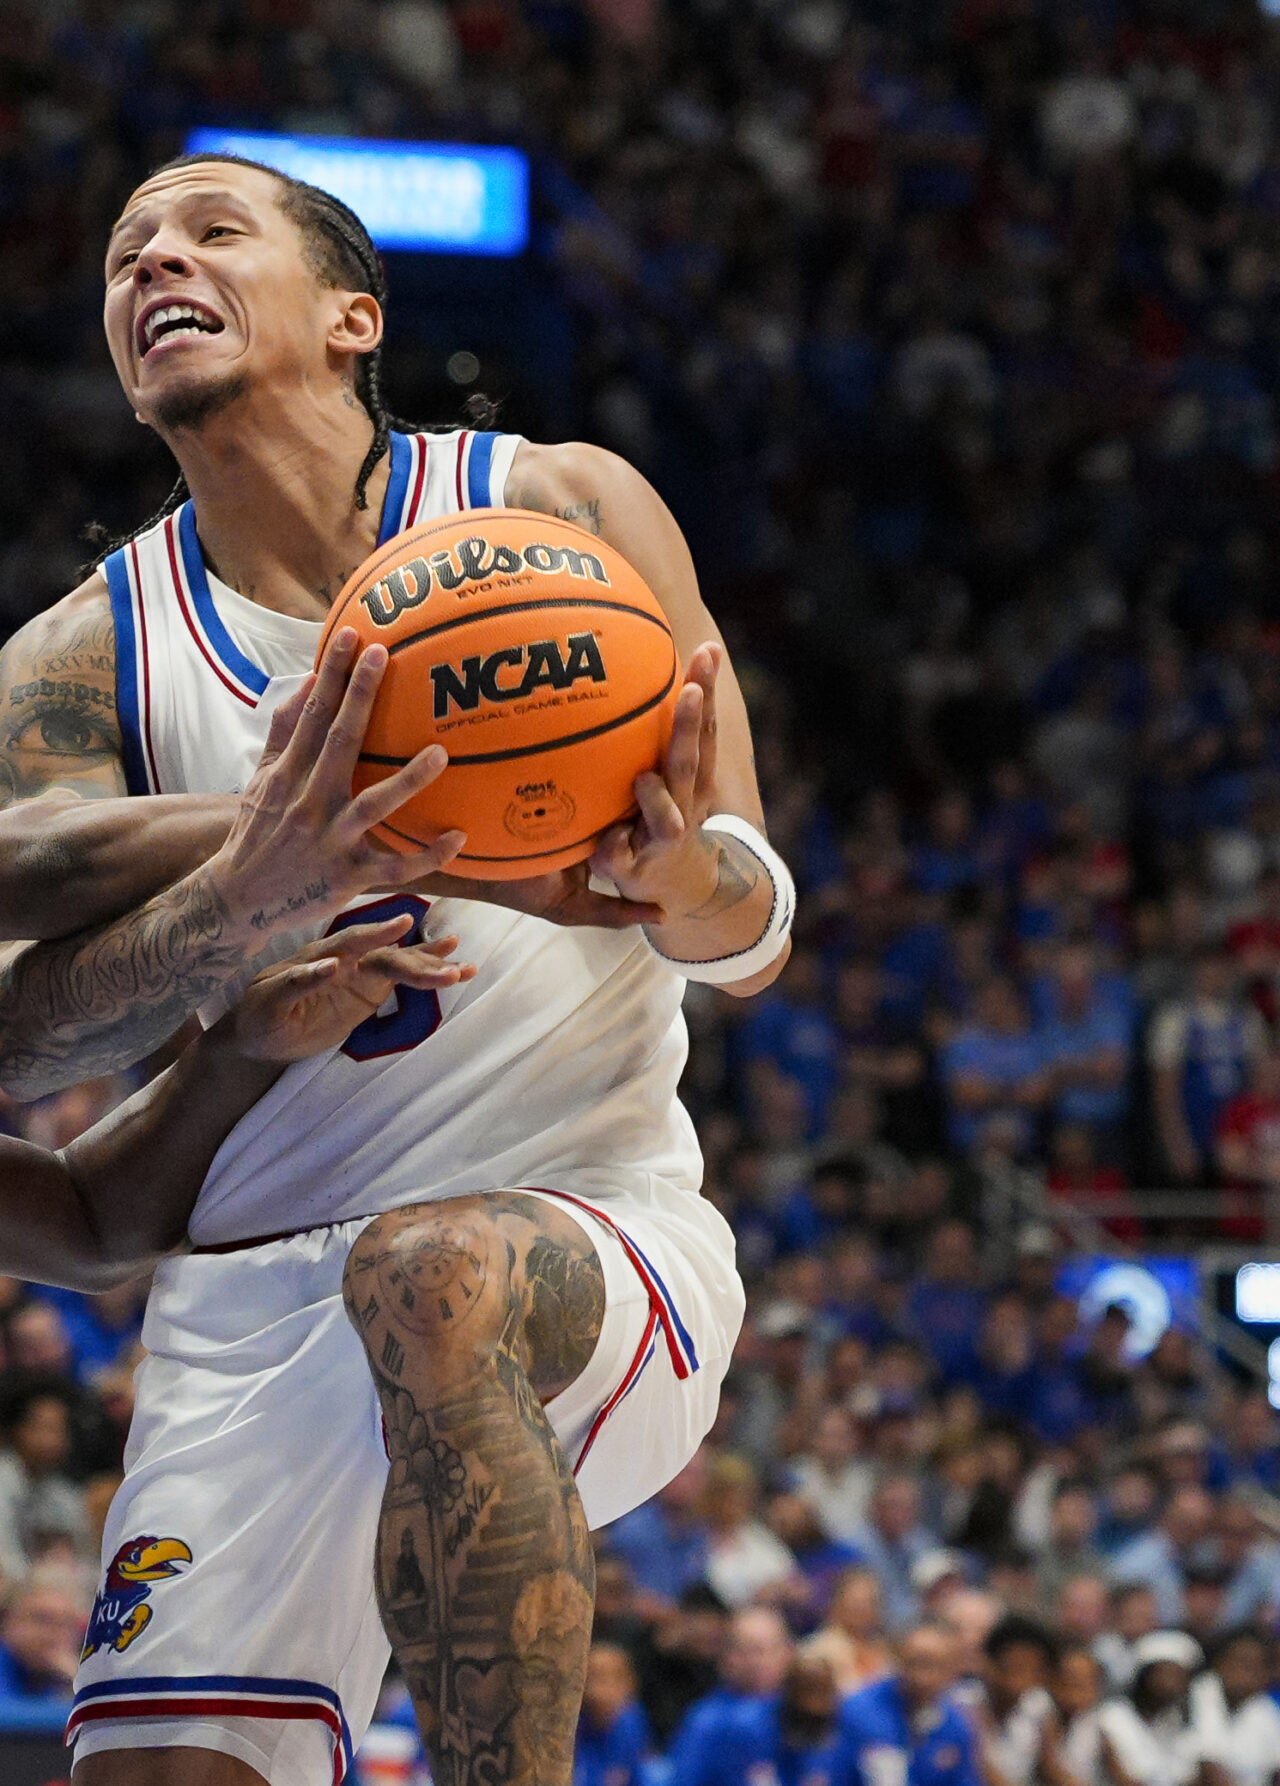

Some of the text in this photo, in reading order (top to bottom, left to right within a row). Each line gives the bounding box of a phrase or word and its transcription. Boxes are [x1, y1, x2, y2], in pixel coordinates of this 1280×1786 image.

[359, 536, 612, 628] Wilson
[456, 582, 492, 600] EVO
[430, 631, 607, 719] NCAA
[436, 689, 609, 733] OFFICIAL GAME BALL
[97, 1600, 120, 1624] KU
